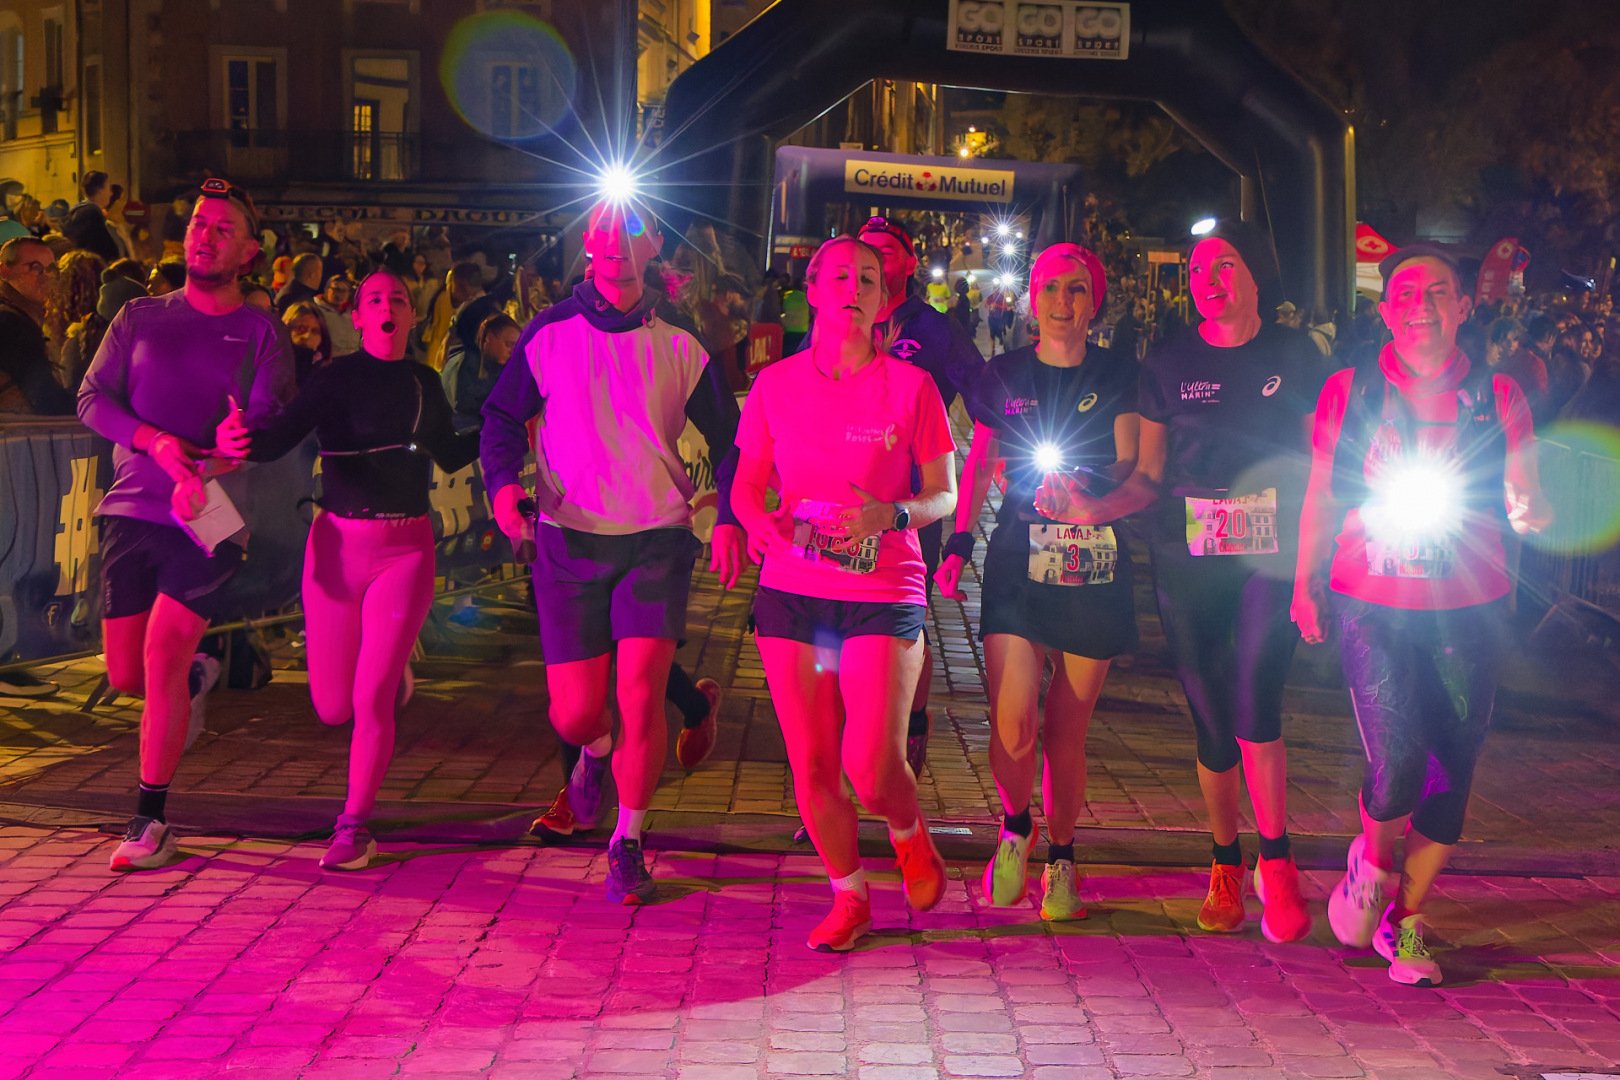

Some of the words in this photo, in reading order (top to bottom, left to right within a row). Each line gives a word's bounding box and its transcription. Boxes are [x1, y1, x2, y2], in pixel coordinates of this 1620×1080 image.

[854, 168, 913, 190] Crédit
[939, 175, 1005, 197] Mutuel
[1181, 391, 1211, 401] MARIN
[1215, 509, 1246, 538] 20
[1066, 543, 1080, 571] 3
